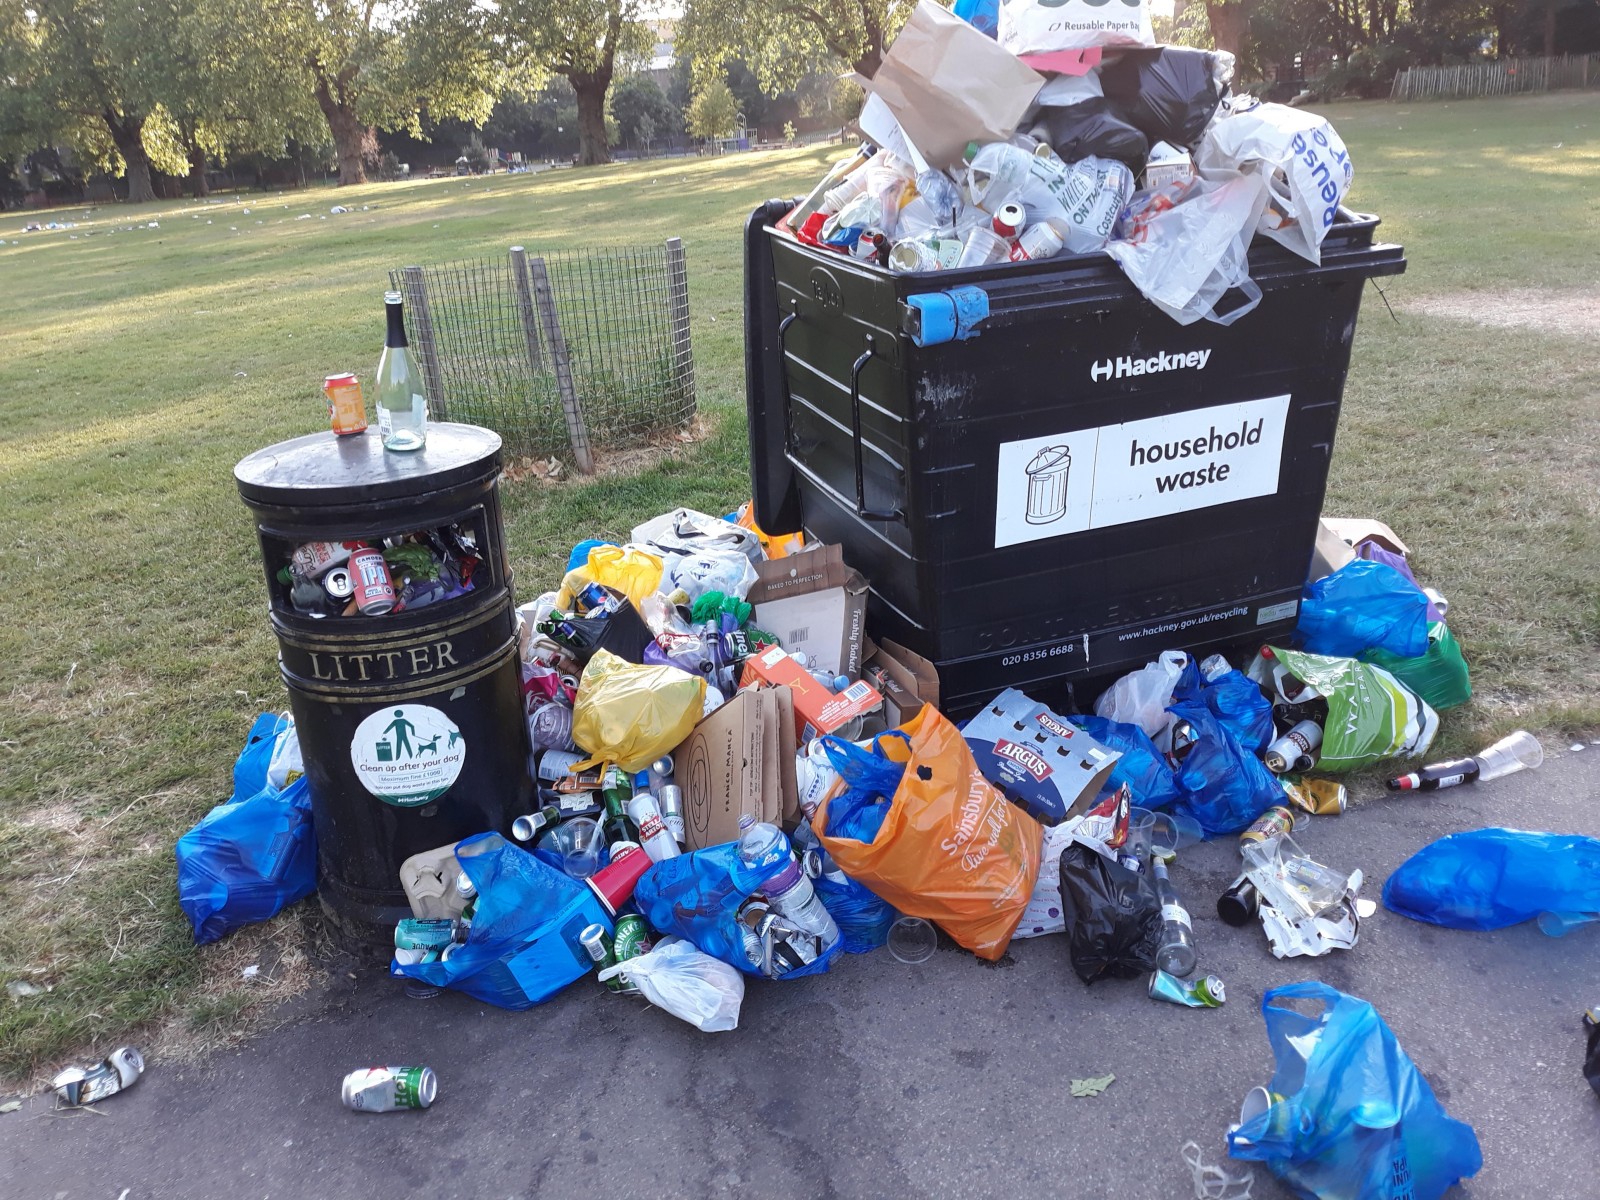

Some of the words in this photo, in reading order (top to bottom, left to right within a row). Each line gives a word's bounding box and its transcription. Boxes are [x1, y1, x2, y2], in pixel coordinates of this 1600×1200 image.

[1064, 21, 1104, 31] Reusable
[1107, 21, 1129, 32] Paper
[1047, 174, 1066, 194] IN
[1292, 133, 1341, 228] Reuse
[1073, 202, 1090, 225] ON
[1115, 348, 1211, 378] Hackney
[1130, 417, 1264, 467] household
[1155, 461, 1230, 493] waste
[360, 565, 387, 588] IPA
[767, 582, 784, 590] BAKED
[793, 573, 823, 584] PERFECTION
[1118, 605, 1249, 643] www.hackney.gov.uk/recycling
[308, 640, 459, 681] LITTER
[848, 642, 859, 673] Baked
[1002, 654, 1021, 667] 020
[1023, 649, 1048, 662] 8356
[1049, 643, 1074, 657] 6688
[1039, 714, 1072, 737] ARGUS
[360, 764, 384, 773] Clean
[386, 765, 397, 773] up
[399, 762, 421, 772] after
[422, 759, 442, 769] your
[443, 753, 459, 764] dog
[997, 742, 1048, 777] ARGUS
[941, 769, 990, 856] Sainsbury's
[988, 815, 1002, 847] well
[411, 942, 438, 951] OPAQUE
[614, 921, 642, 956] HEINEKE
